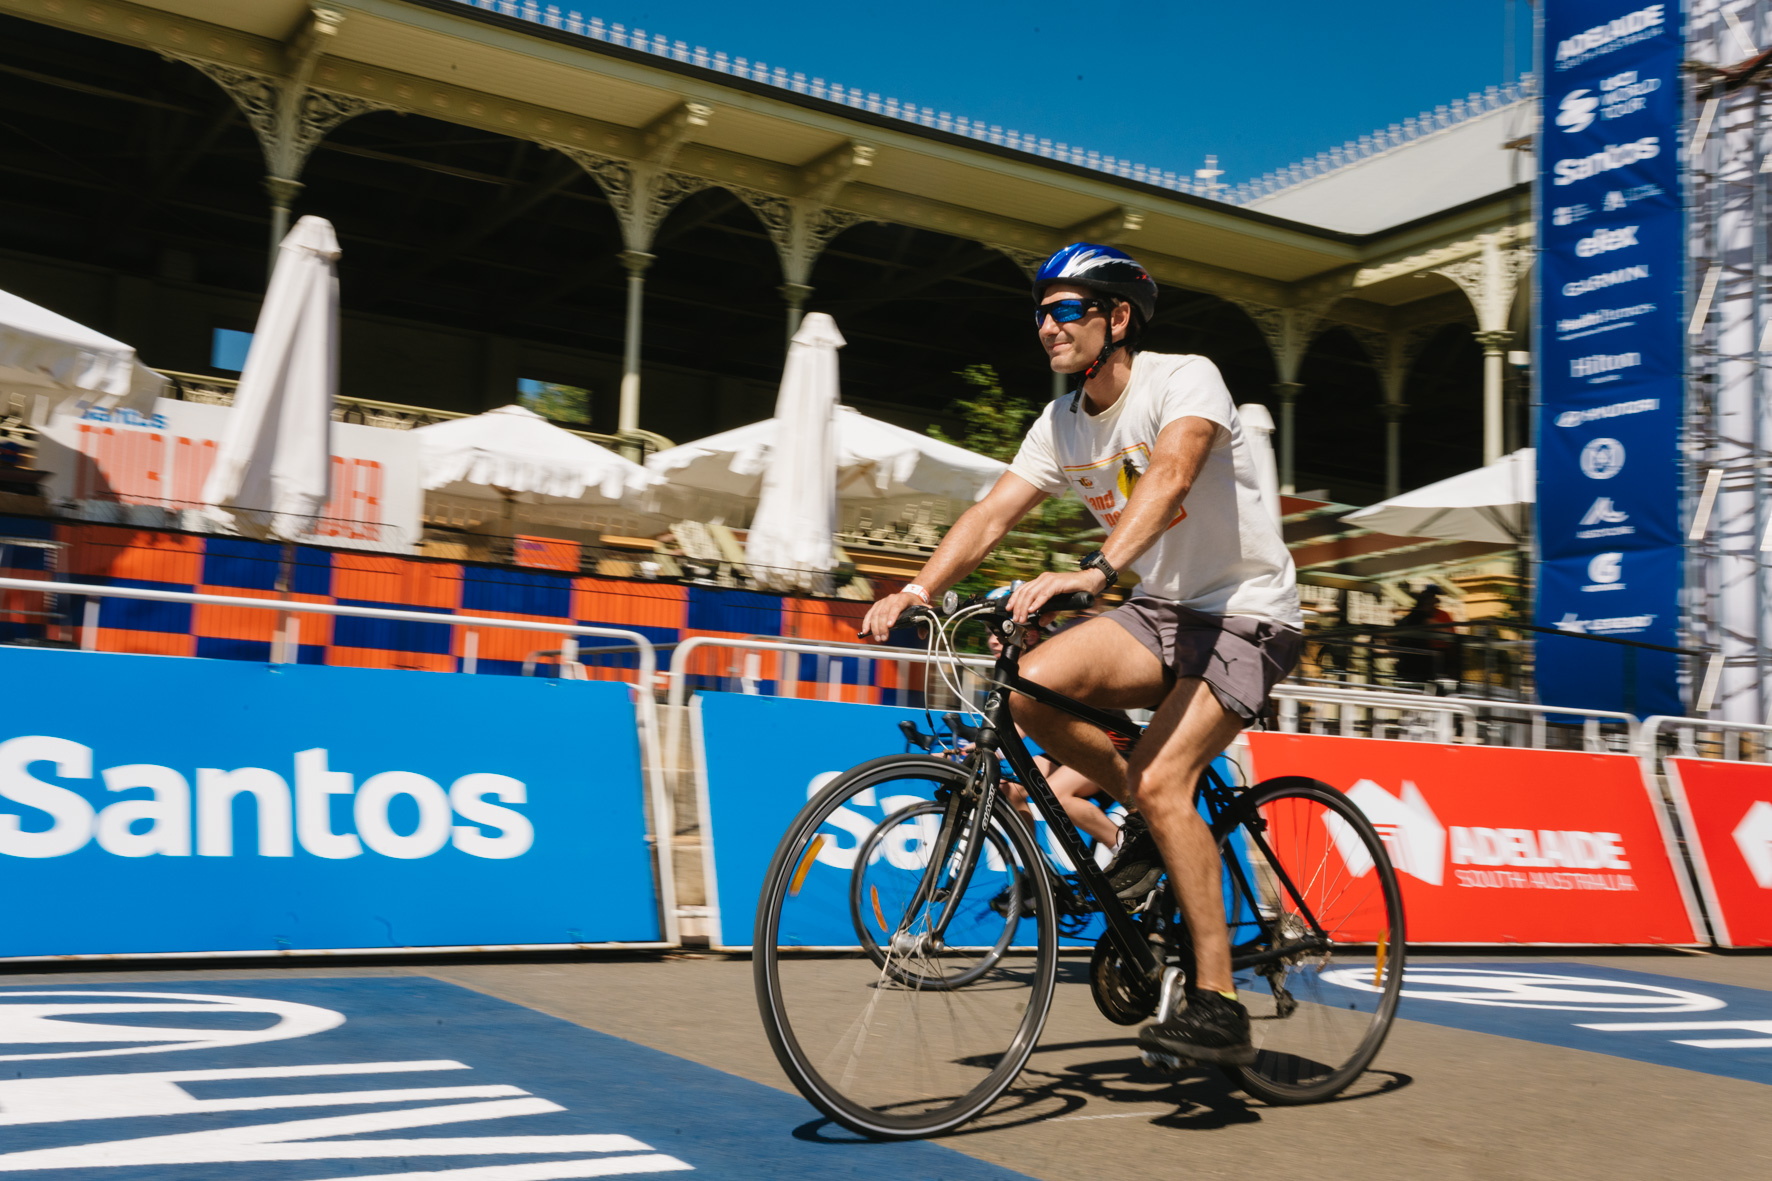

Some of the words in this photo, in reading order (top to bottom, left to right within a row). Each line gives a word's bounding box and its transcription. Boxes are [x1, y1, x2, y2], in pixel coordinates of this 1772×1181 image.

[1553, 136, 1662, 186] Santos
[1569, 351, 1643, 378] Hilton
[0, 735, 536, 861] Santos
[981, 783, 998, 832] GIANT
[1448, 825, 1633, 870] ADELAIDE
[1454, 869, 1529, 889] SOUTH
[1527, 871, 1640, 892] AUSTRALIA
